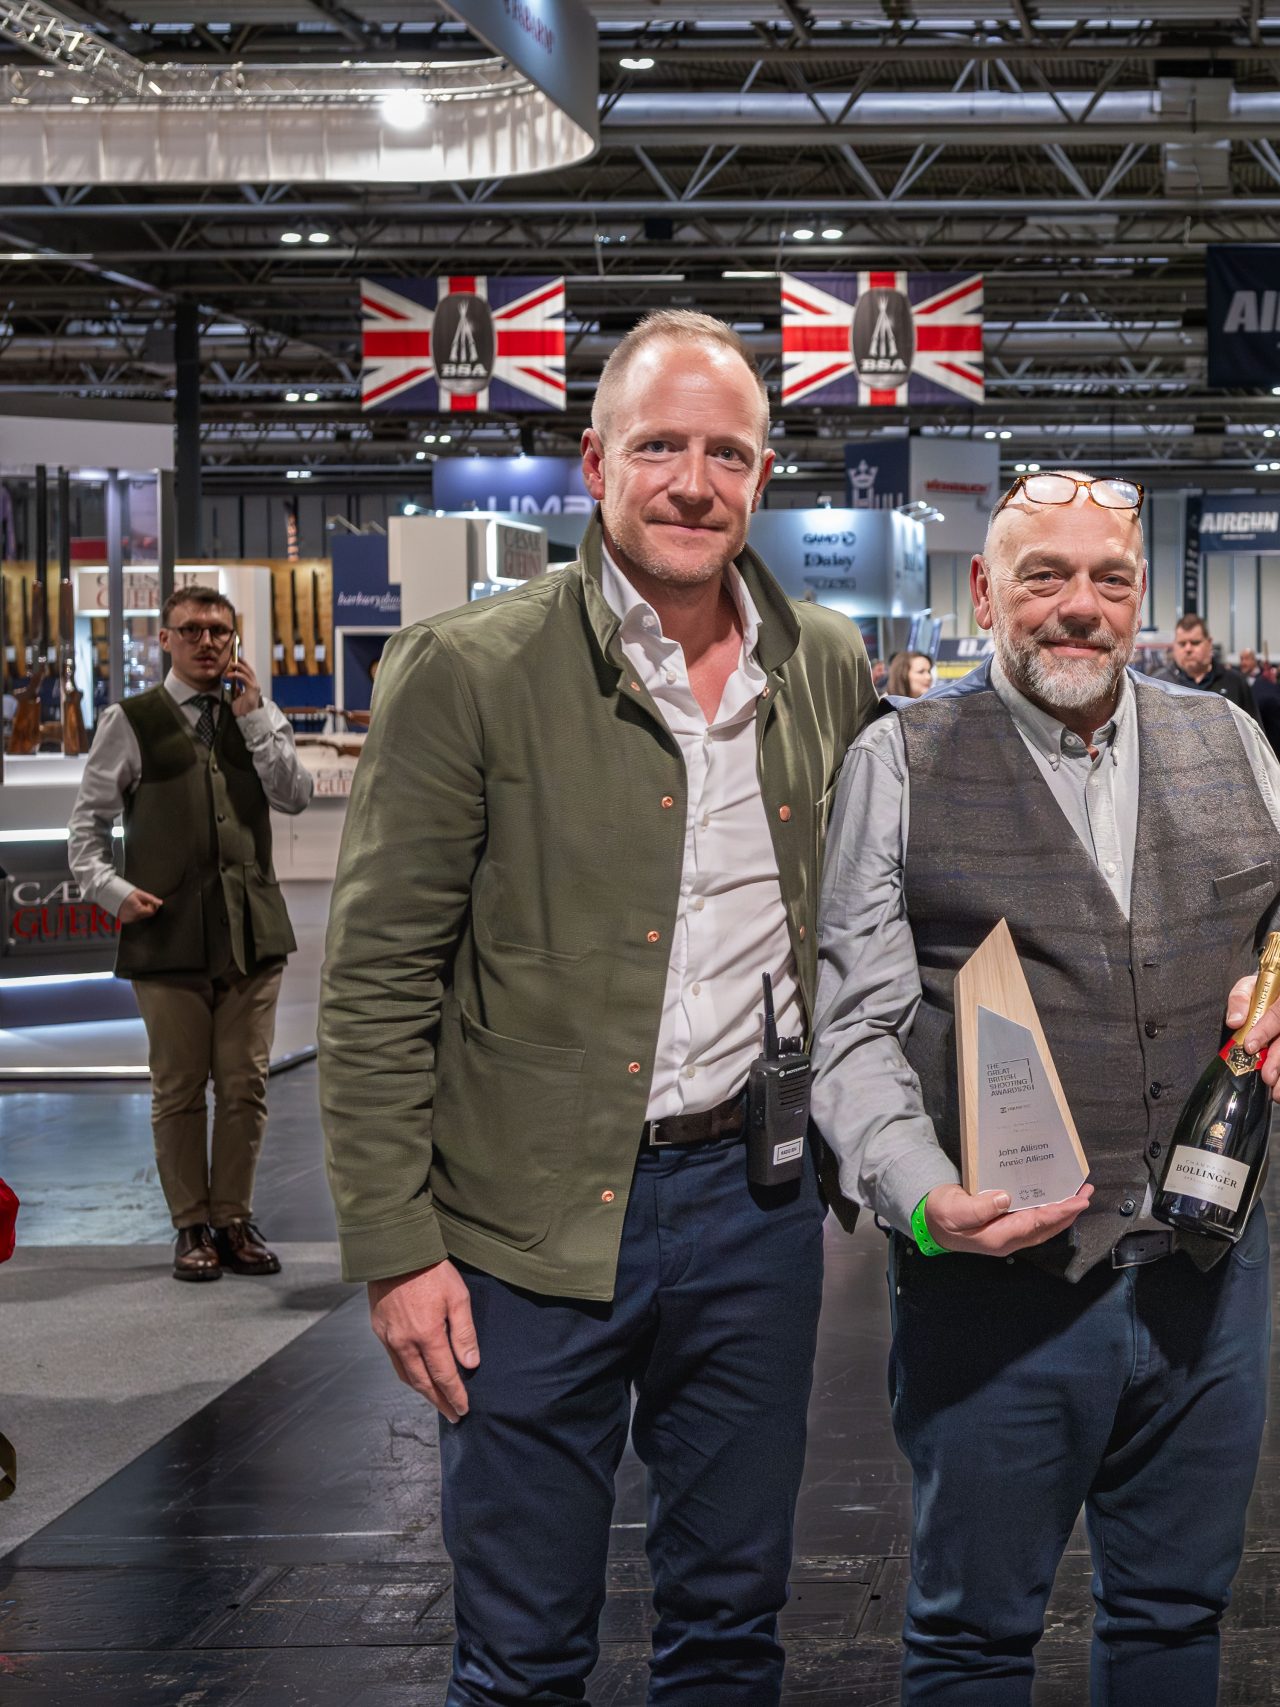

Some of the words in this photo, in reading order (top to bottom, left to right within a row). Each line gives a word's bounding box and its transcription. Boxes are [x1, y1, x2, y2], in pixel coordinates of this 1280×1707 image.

[440, 363, 488, 377] BSA
[860, 358, 907, 372] BSA
[1199, 512, 1279, 533] AIRGUN
[987, 1068, 1010, 1077] GREAT
[988, 1073, 1017, 1083] BRITISH
[989, 1079, 1028, 1089] SHOOTING
[999, 1148, 1018, 1157] John
[1020, 1142, 1049, 1153] Allison
[999, 1158, 1024, 1168] Annie
[1025, 1153, 1055, 1164] Allison
[1175, 1164, 1238, 1188] BOLLINGER
